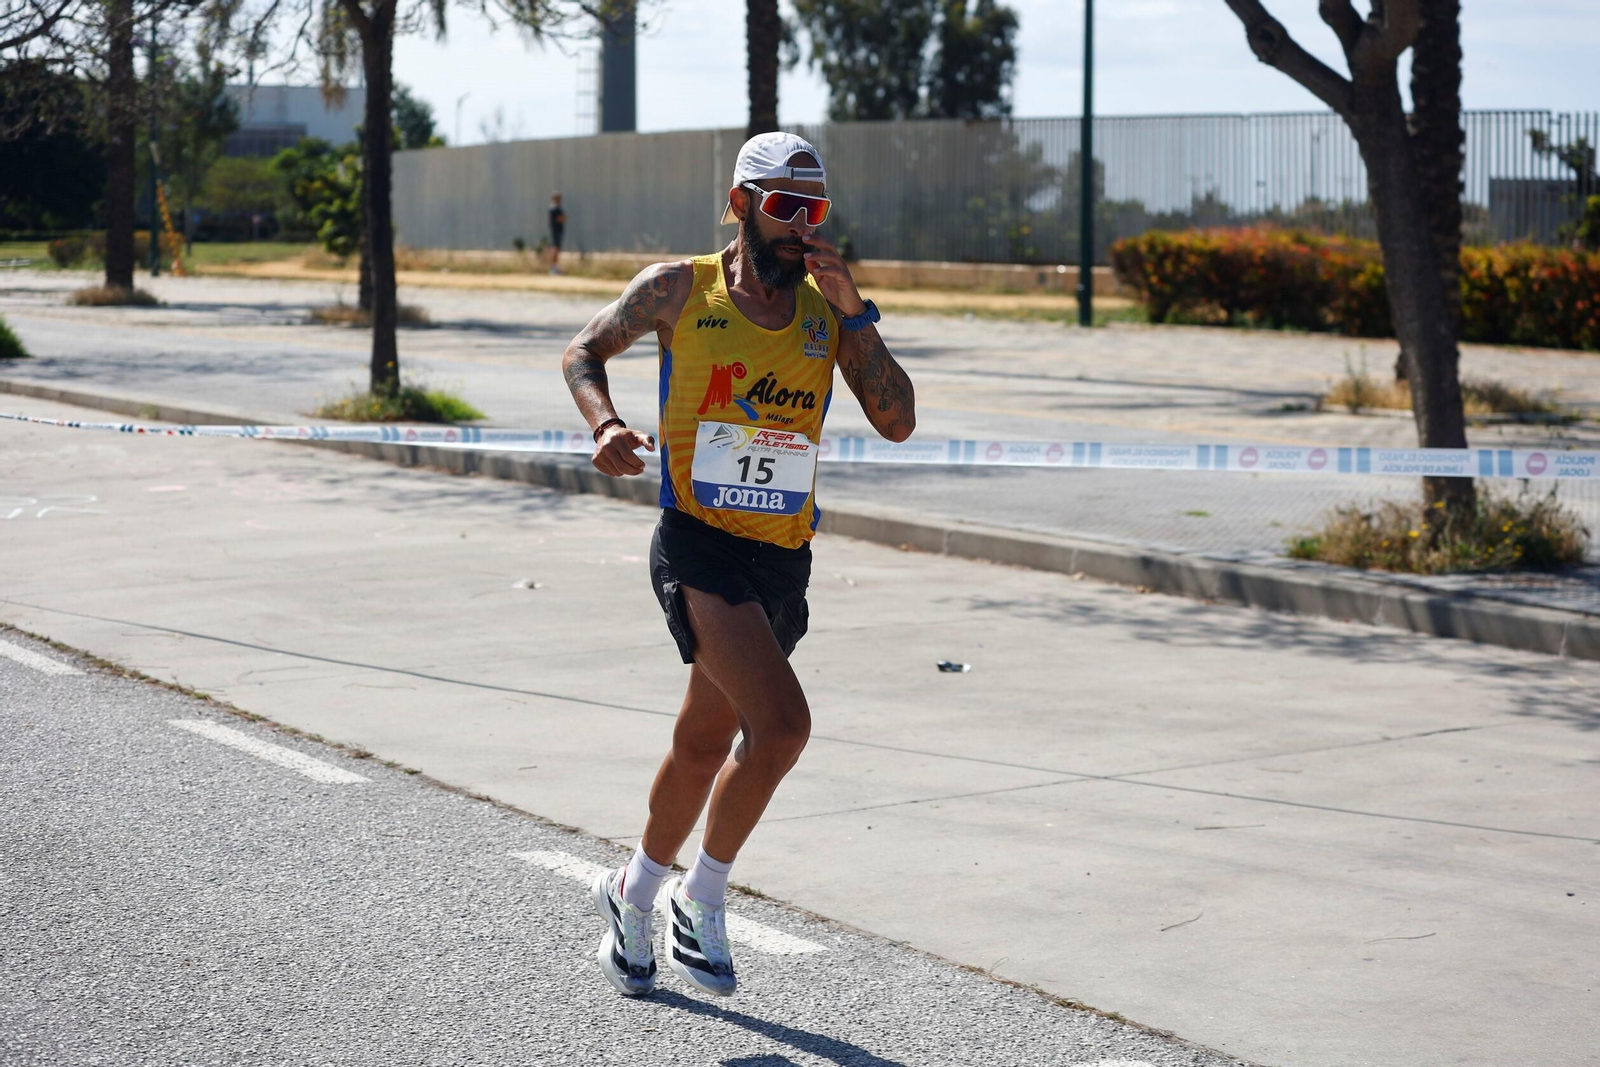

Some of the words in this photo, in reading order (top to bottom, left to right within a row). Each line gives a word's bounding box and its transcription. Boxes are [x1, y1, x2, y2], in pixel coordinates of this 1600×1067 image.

[745, 371, 816, 410] Álora
[765, 413, 795, 425] Málaga
[757, 430, 796, 442] RFEA
[751, 438, 810, 451] ATLETISMO
[747, 445, 772, 453] RUTA
[772, 449, 810, 458] RUNNING
[736, 455, 776, 485] 15
